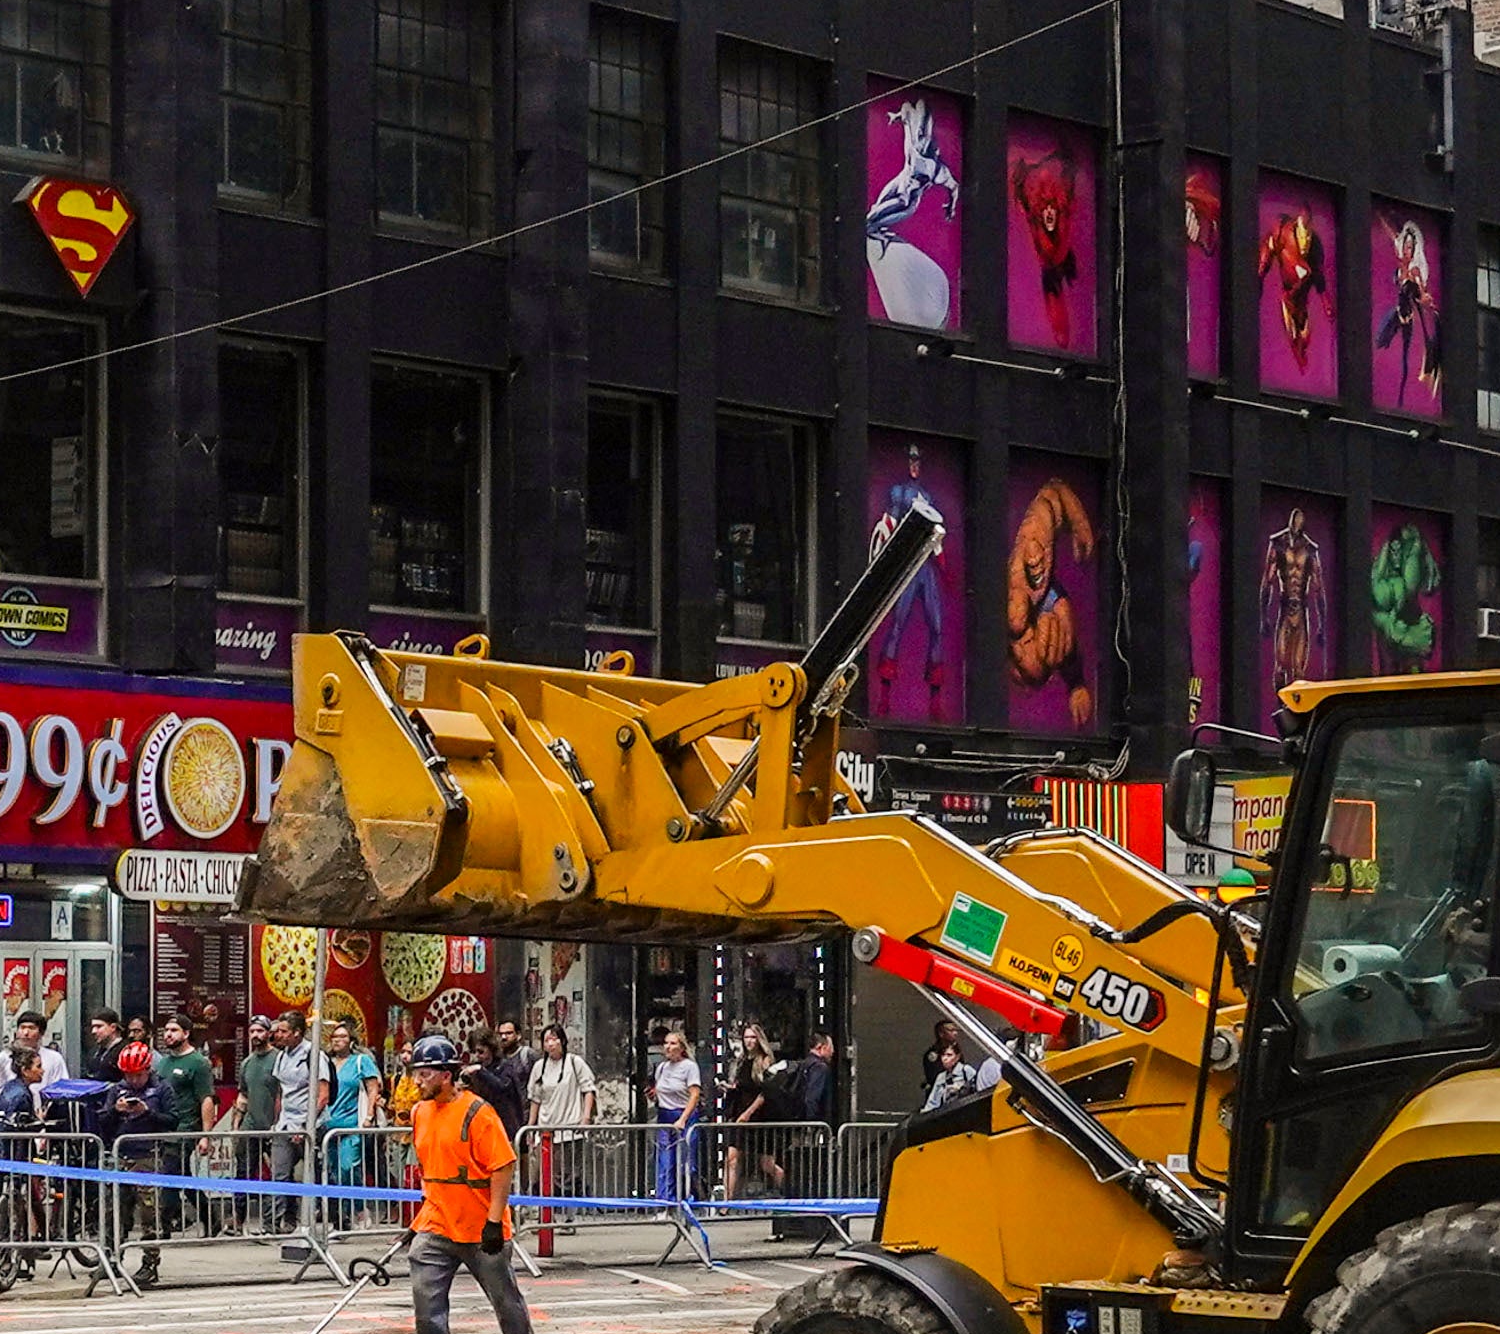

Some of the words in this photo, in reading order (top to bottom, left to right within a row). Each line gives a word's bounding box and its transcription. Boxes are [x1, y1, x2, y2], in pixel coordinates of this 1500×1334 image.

[25, 610, 67, 628] COMICS
[216, 622, 277, 660] azing
[137, 714, 178, 833] DELICIOUS
[126, 856, 159, 893] PIZZA
[165, 858, 199, 894] PASTA
[1055, 941, 1081, 967] BL46
[1081, 968, 1150, 1024] 450
